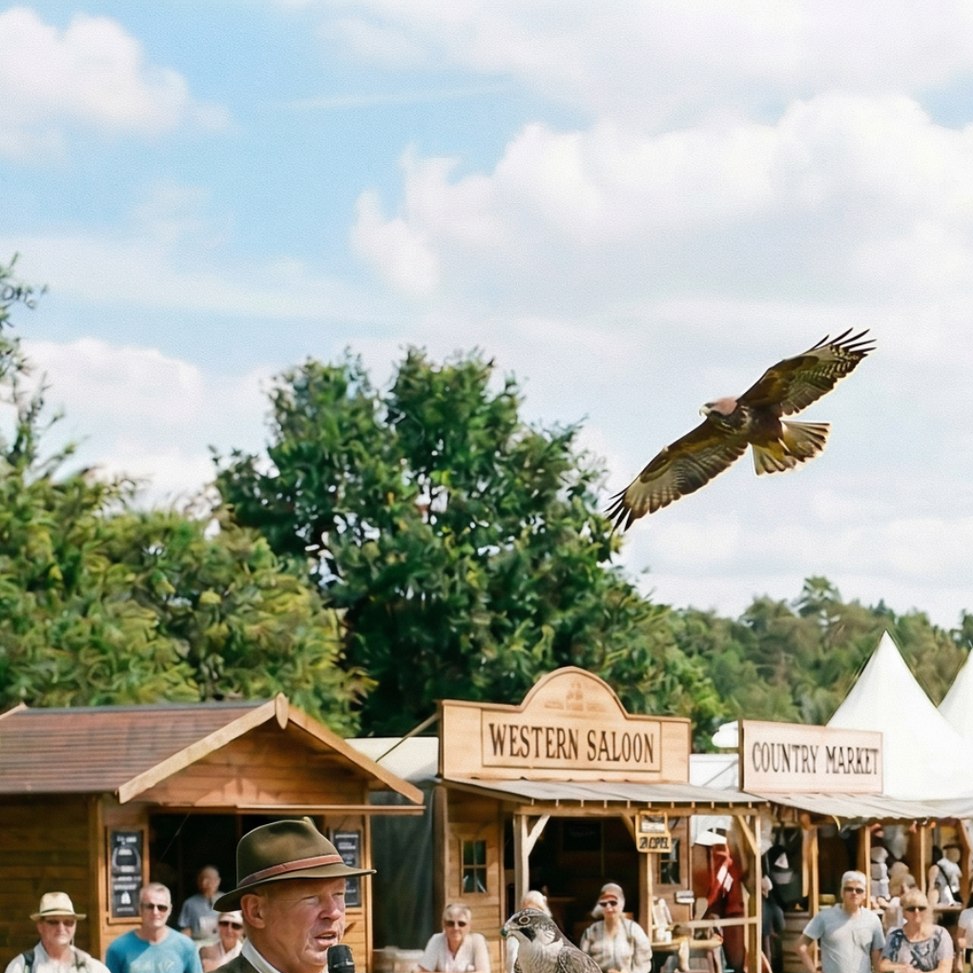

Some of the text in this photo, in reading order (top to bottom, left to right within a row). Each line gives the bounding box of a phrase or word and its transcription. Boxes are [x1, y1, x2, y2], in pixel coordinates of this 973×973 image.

[489, 723, 654, 764] WESTERN SALOON
[752, 741, 879, 775] COUNTRY MARKET
